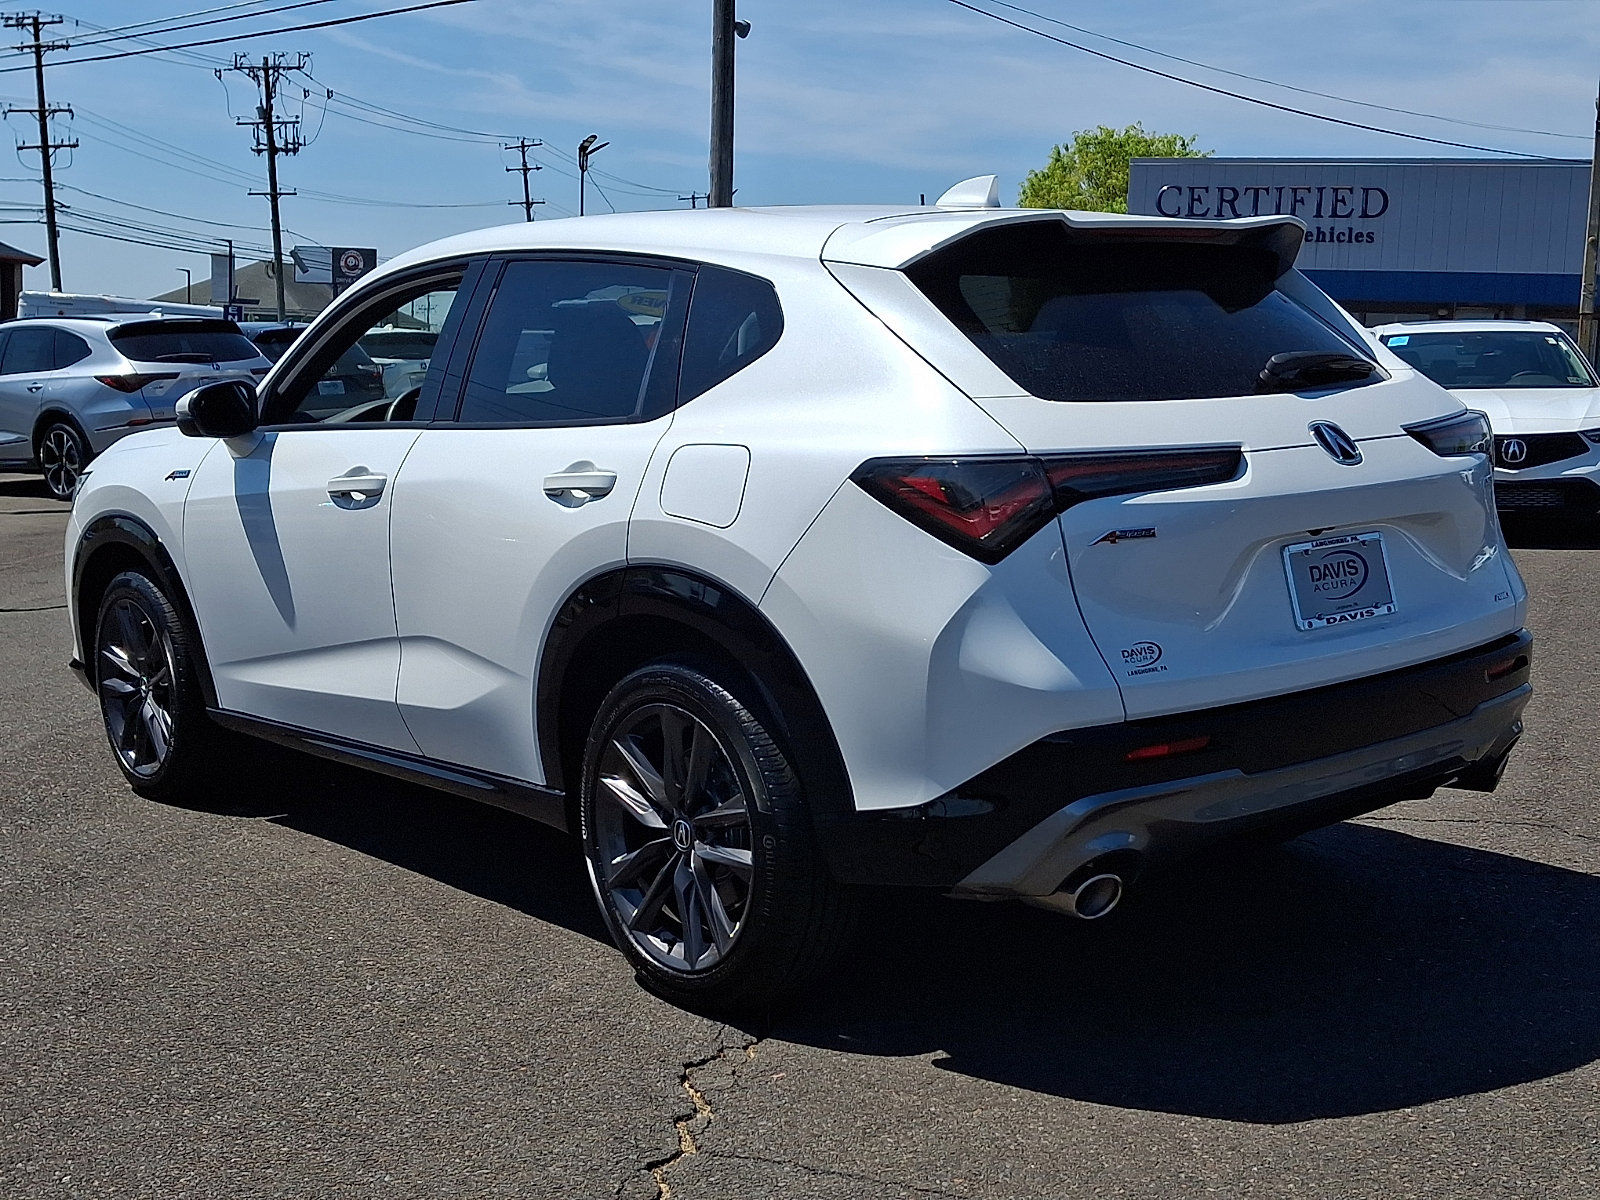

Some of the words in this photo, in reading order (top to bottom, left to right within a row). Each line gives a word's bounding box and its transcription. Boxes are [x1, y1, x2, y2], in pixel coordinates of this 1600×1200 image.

[1156, 185, 1390, 218] CERTIFIED
[1304, 227, 1375, 243] ehicles
[1309, 559, 1359, 583] DAVIS
[1313, 578, 1357, 592] ACURA
[1326, 609, 1375, 625] DAVIS
[1121, 646, 1155, 659] DAVIS
[1124, 655, 1154, 664] ACURA
